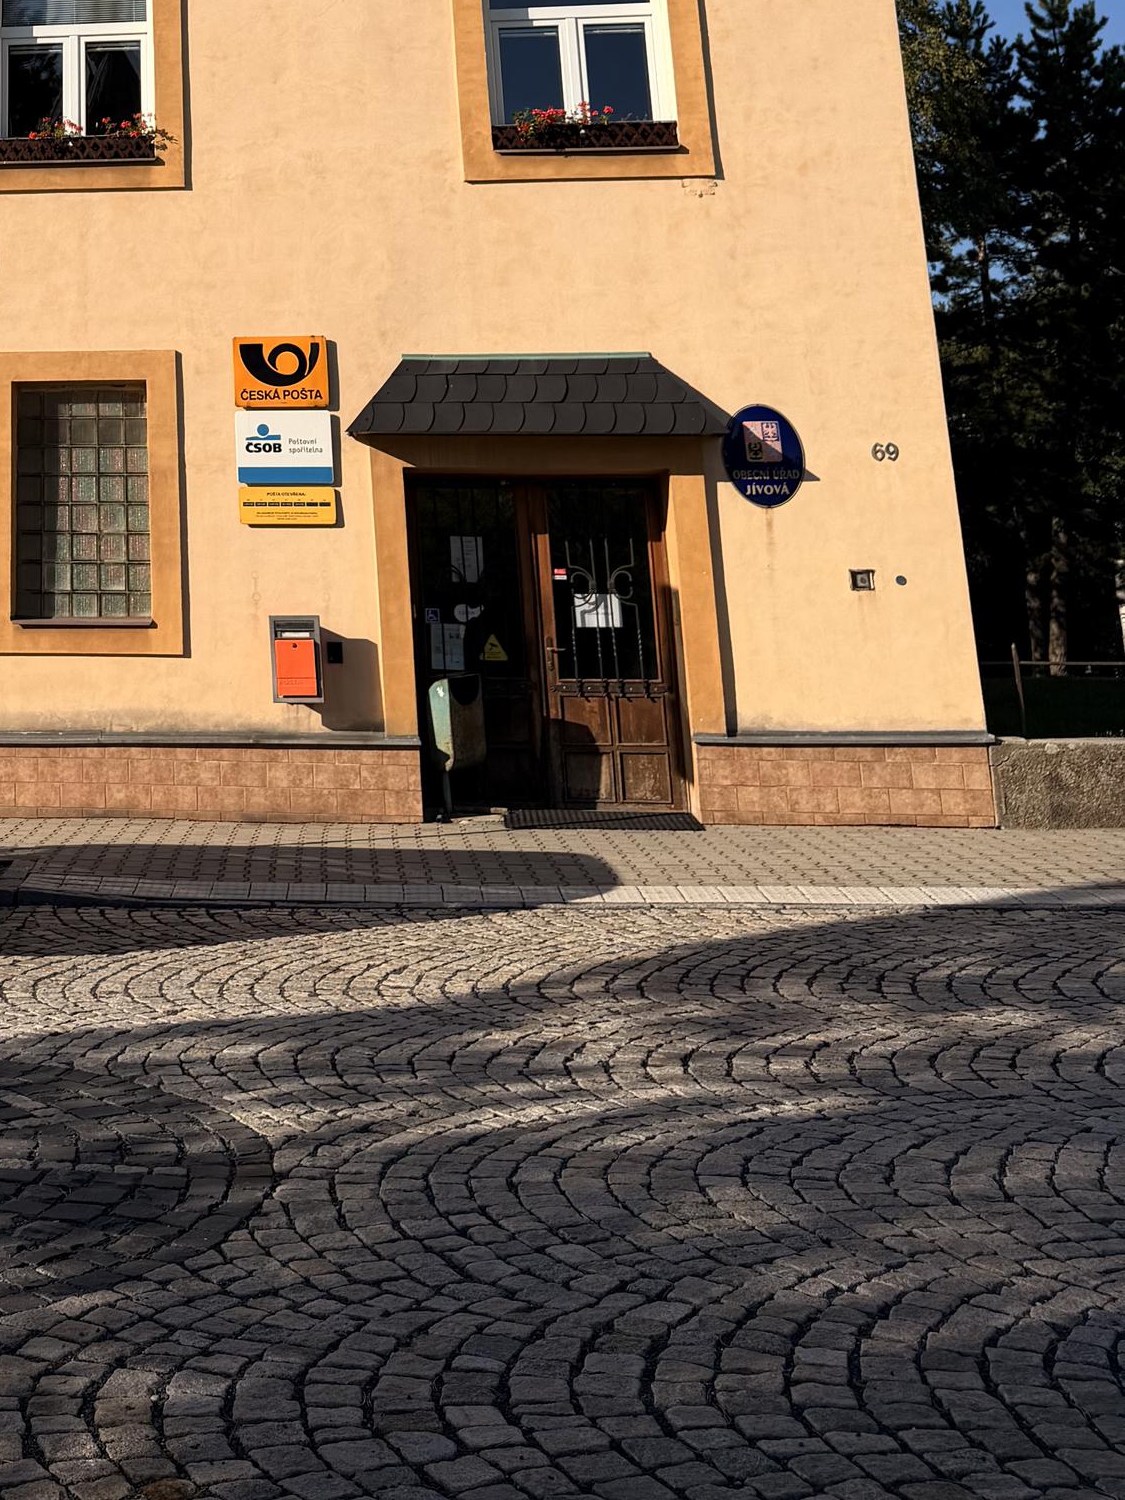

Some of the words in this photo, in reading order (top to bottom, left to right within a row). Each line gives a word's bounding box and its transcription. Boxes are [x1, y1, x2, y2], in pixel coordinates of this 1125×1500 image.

[240, 388, 280, 401] ČESKÁ
[283, 388, 323, 400] POŠTA
[245, 442, 282, 453] ČSOB
[288, 446, 323, 454] spořitelna
[872, 443, 899, 462] 69
[732, 467, 770, 480] OBECNÍ
[773, 467, 800, 479] ÚŘAD
[745, 482, 790, 496] JÍVOVÁ
